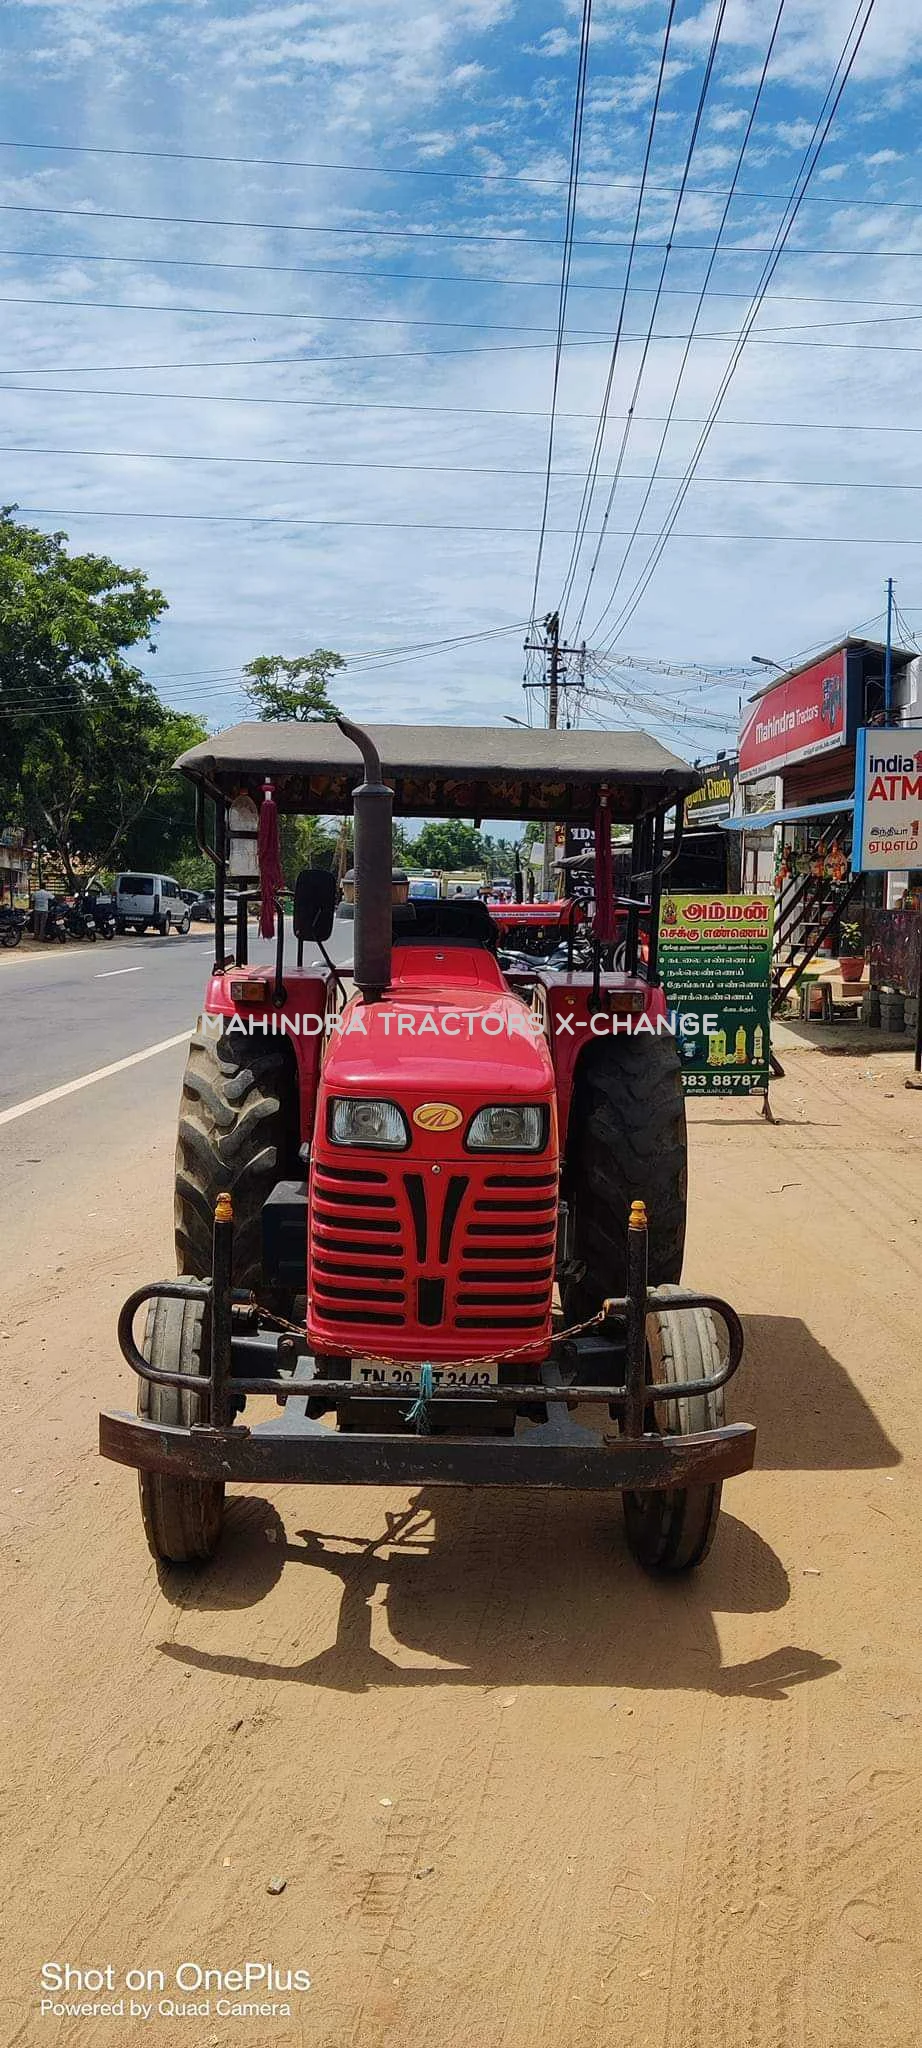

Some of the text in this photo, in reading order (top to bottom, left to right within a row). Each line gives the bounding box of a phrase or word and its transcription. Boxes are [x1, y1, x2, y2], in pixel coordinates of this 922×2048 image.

[755, 704, 819, 745] Mahindra Tractors
[868, 776, 922, 801] ATM
[870, 826, 908, 838] இந்தியா
[868, 837, 918, 854] ஏடிஎம்
[681, 901, 770, 923] அம்மன்
[659, 926, 769, 942] செக்கு எண்ணெய்
[666, 980, 715, 989] தேங்காய்
[712, 1074, 761, 1086] 88787
[360, 1368, 386, 1382] TN
